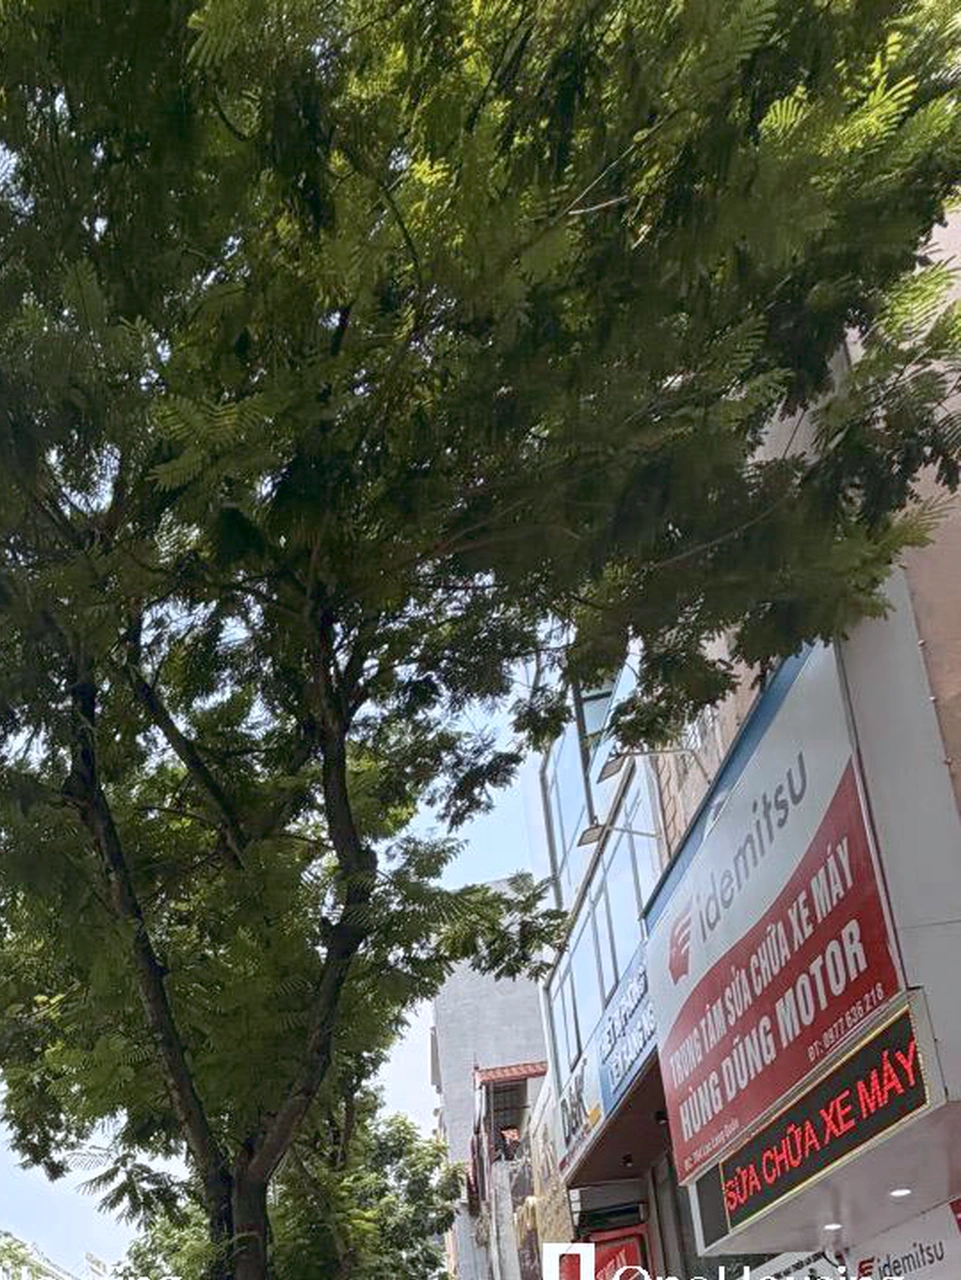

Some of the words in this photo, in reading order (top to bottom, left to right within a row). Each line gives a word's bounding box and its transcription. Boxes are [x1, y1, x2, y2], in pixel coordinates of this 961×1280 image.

[697, 750, 808, 942] idemitsu
[669, 1026, 703, 1089] TRUNG
[750, 921, 791, 997] CHỮA
[788, 889, 814, 952] XE
[810, 837, 853, 924] MÁY
[680, 1070, 723, 1142] HÙNG
[721, 1015, 777, 1102] DŨNG
[775, 918, 868, 1049] MOTOR
[724, 1165, 762, 1211] SỬA
[762, 1119, 821, 1185] CHỮA
[819, 1089, 857, 1146] XE
[857, 1038, 917, 1120] MÁY
